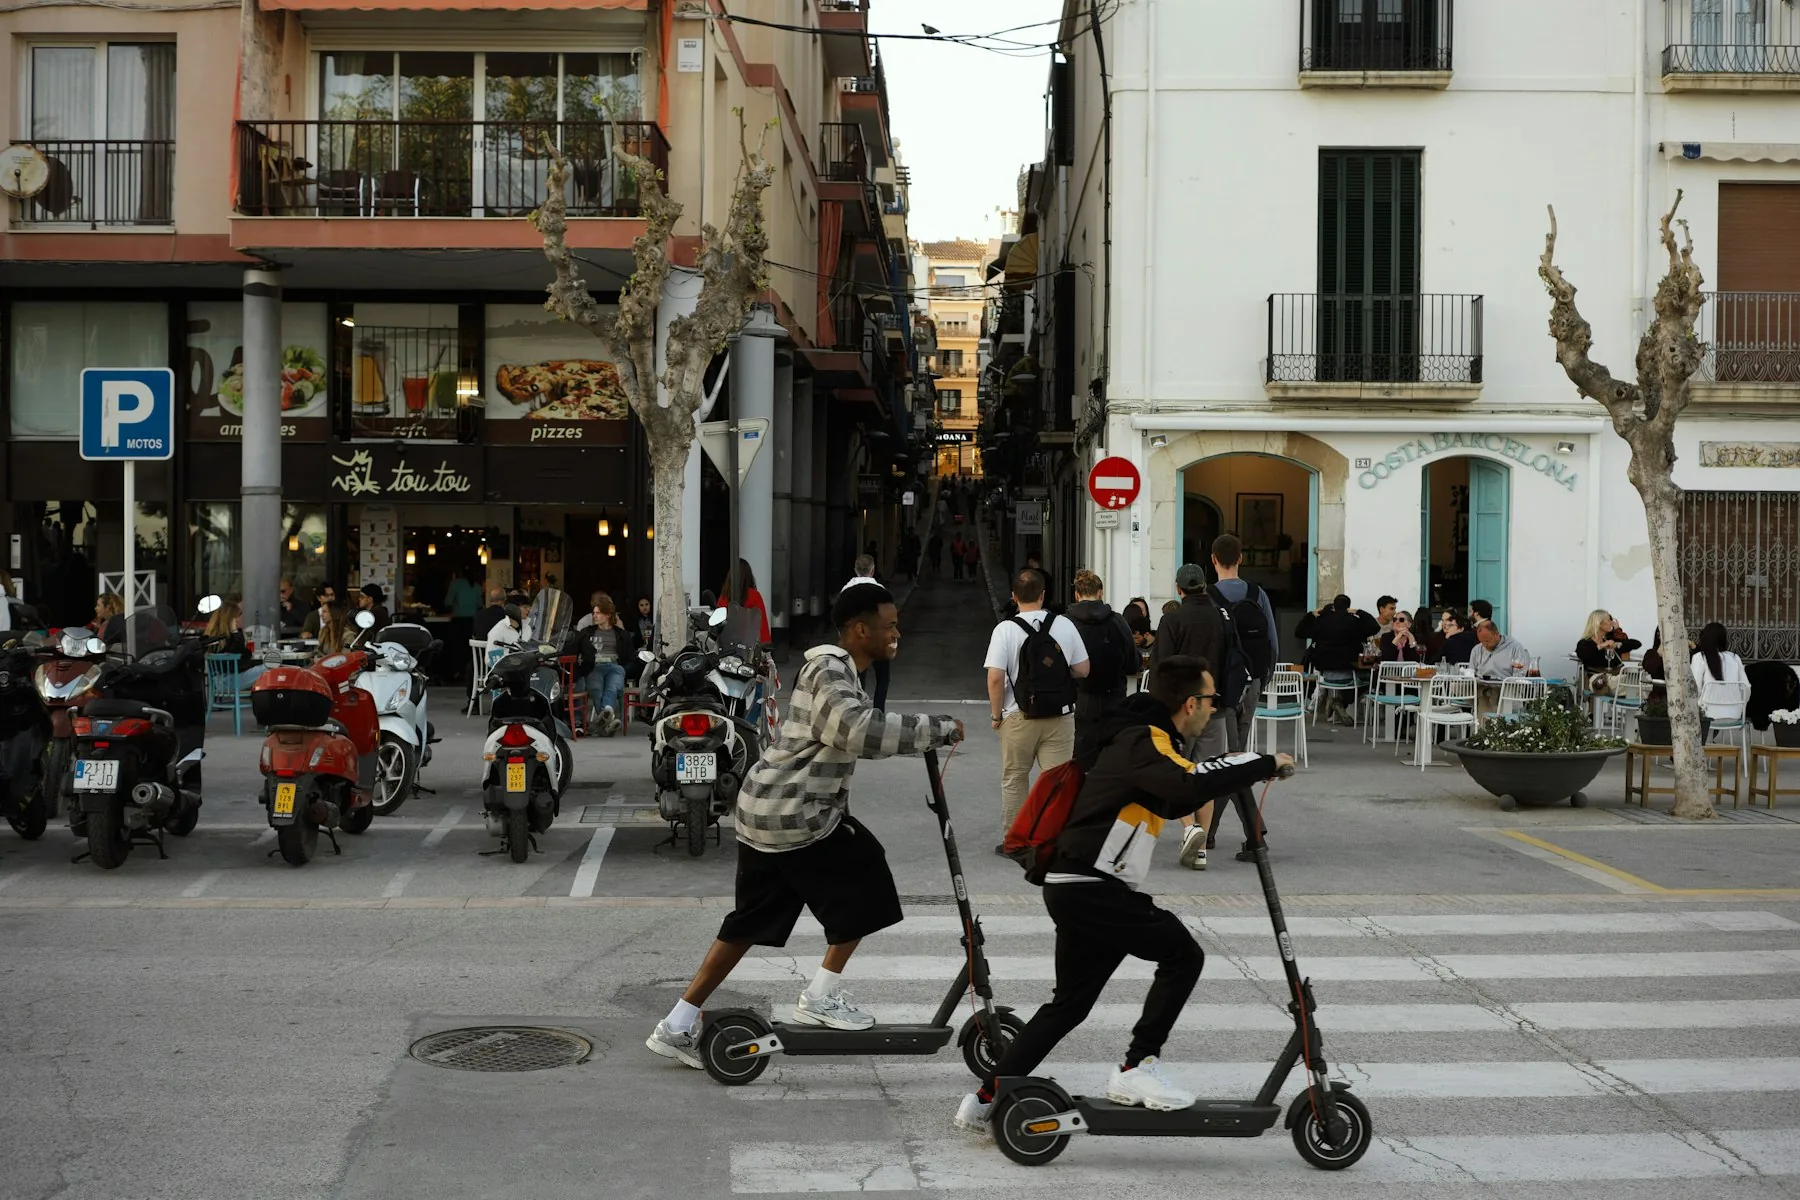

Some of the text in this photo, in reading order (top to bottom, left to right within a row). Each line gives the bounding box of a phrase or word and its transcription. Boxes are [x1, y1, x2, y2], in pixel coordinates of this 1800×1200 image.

[101, 380, 155, 448] P
[219, 424, 297, 436] ames
[530, 423, 584, 442] pizzes
[126, 438, 163, 450] MOTOS
[1431, 431, 1580, 493] BARCELONA
[386, 460, 471, 492] tou tou
[685, 755, 714, 766] 3829
[685, 766, 707, 778] HTB
[956, 879, 965, 897] PRO
[1281, 937, 1292, 957] PRO
